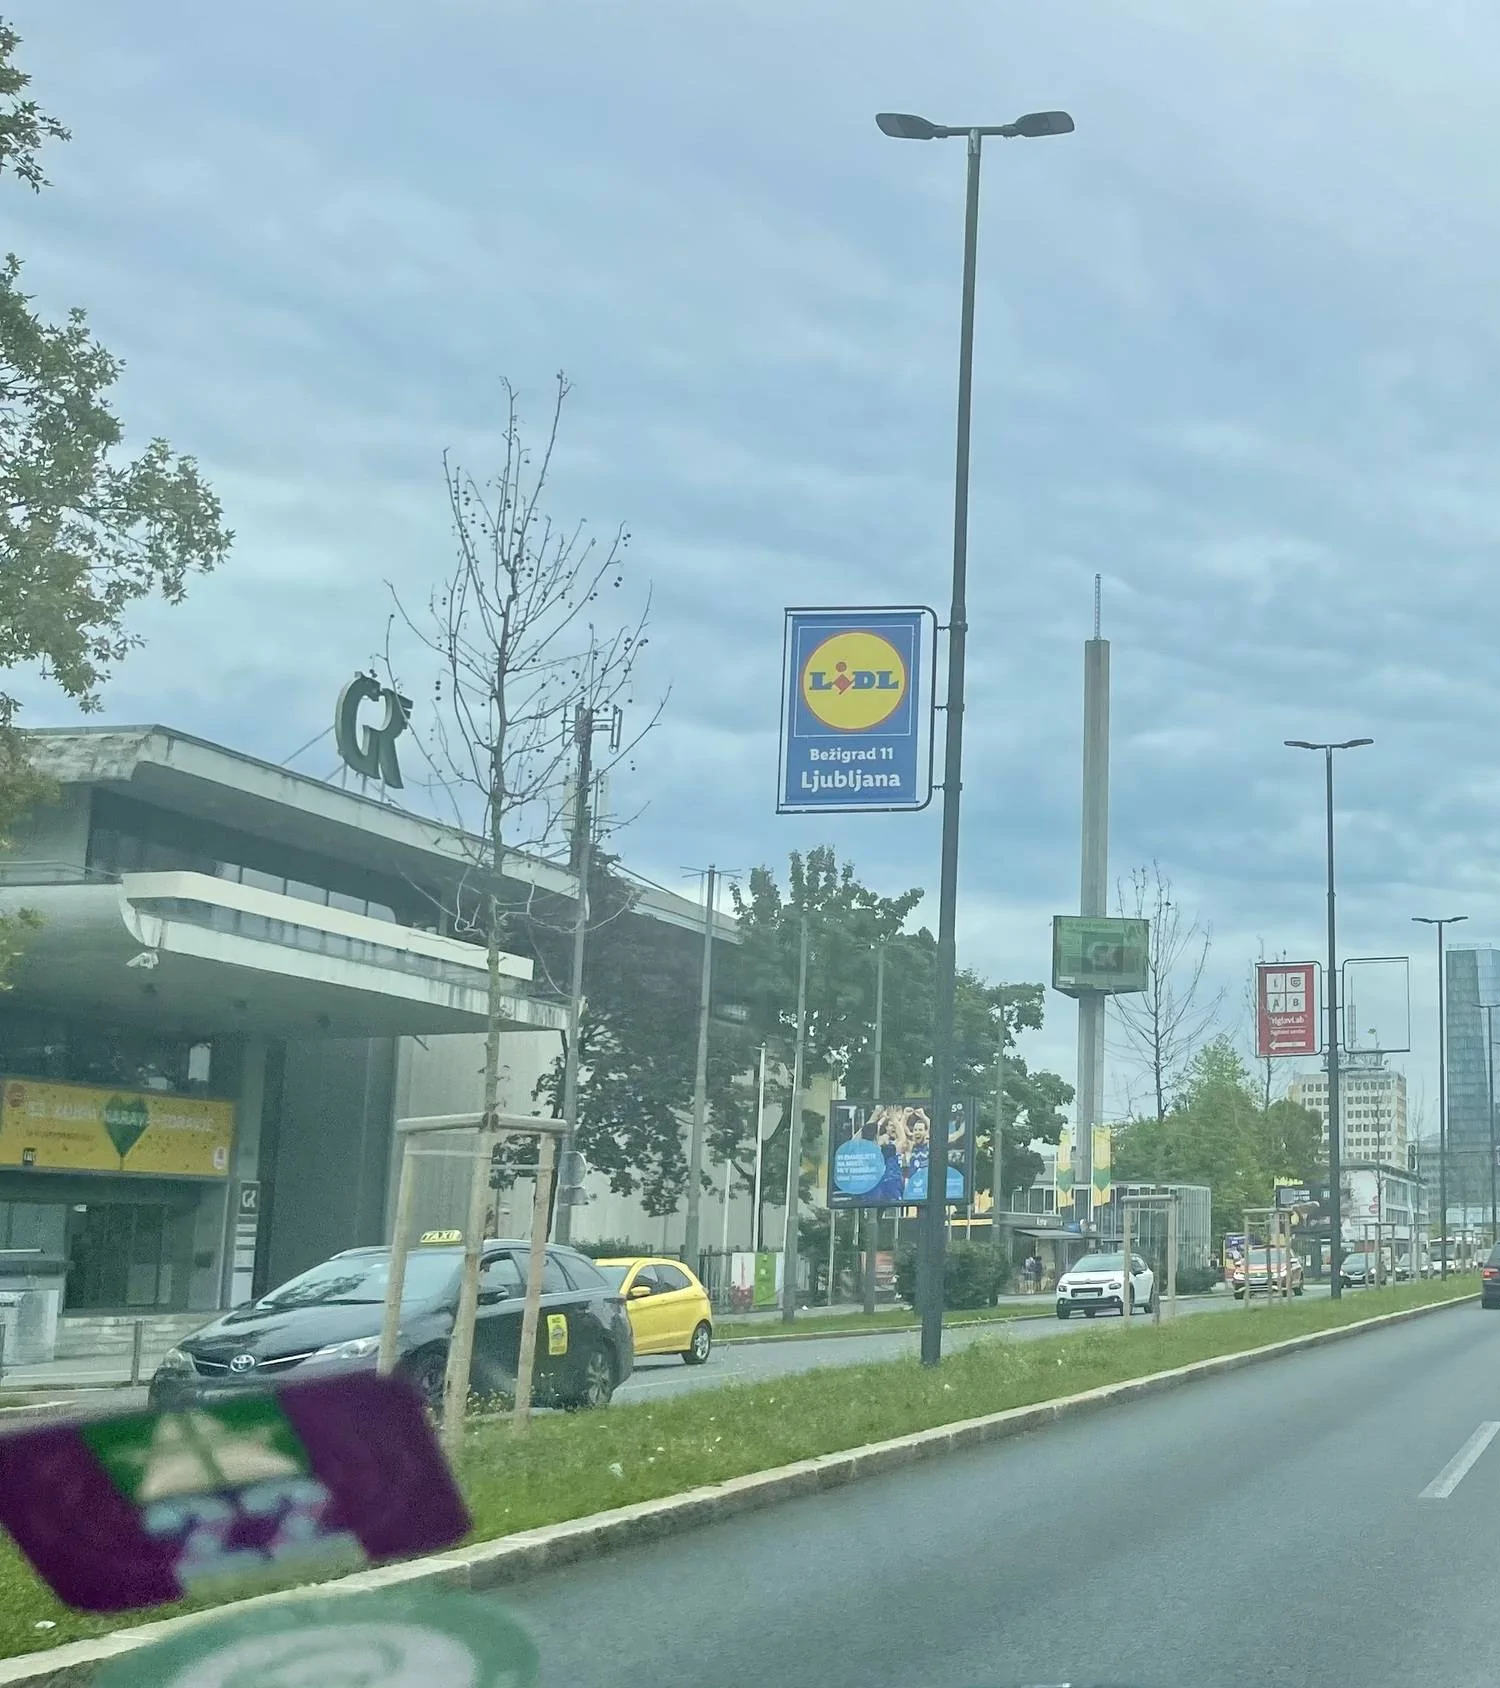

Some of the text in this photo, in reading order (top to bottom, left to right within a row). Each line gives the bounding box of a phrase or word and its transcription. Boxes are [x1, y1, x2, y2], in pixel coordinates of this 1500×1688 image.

[809, 747, 893, 763] Bežigrad 11
[801, 769, 901, 792] Ljubljana
[422, 1231, 455, 1240] TAXI
